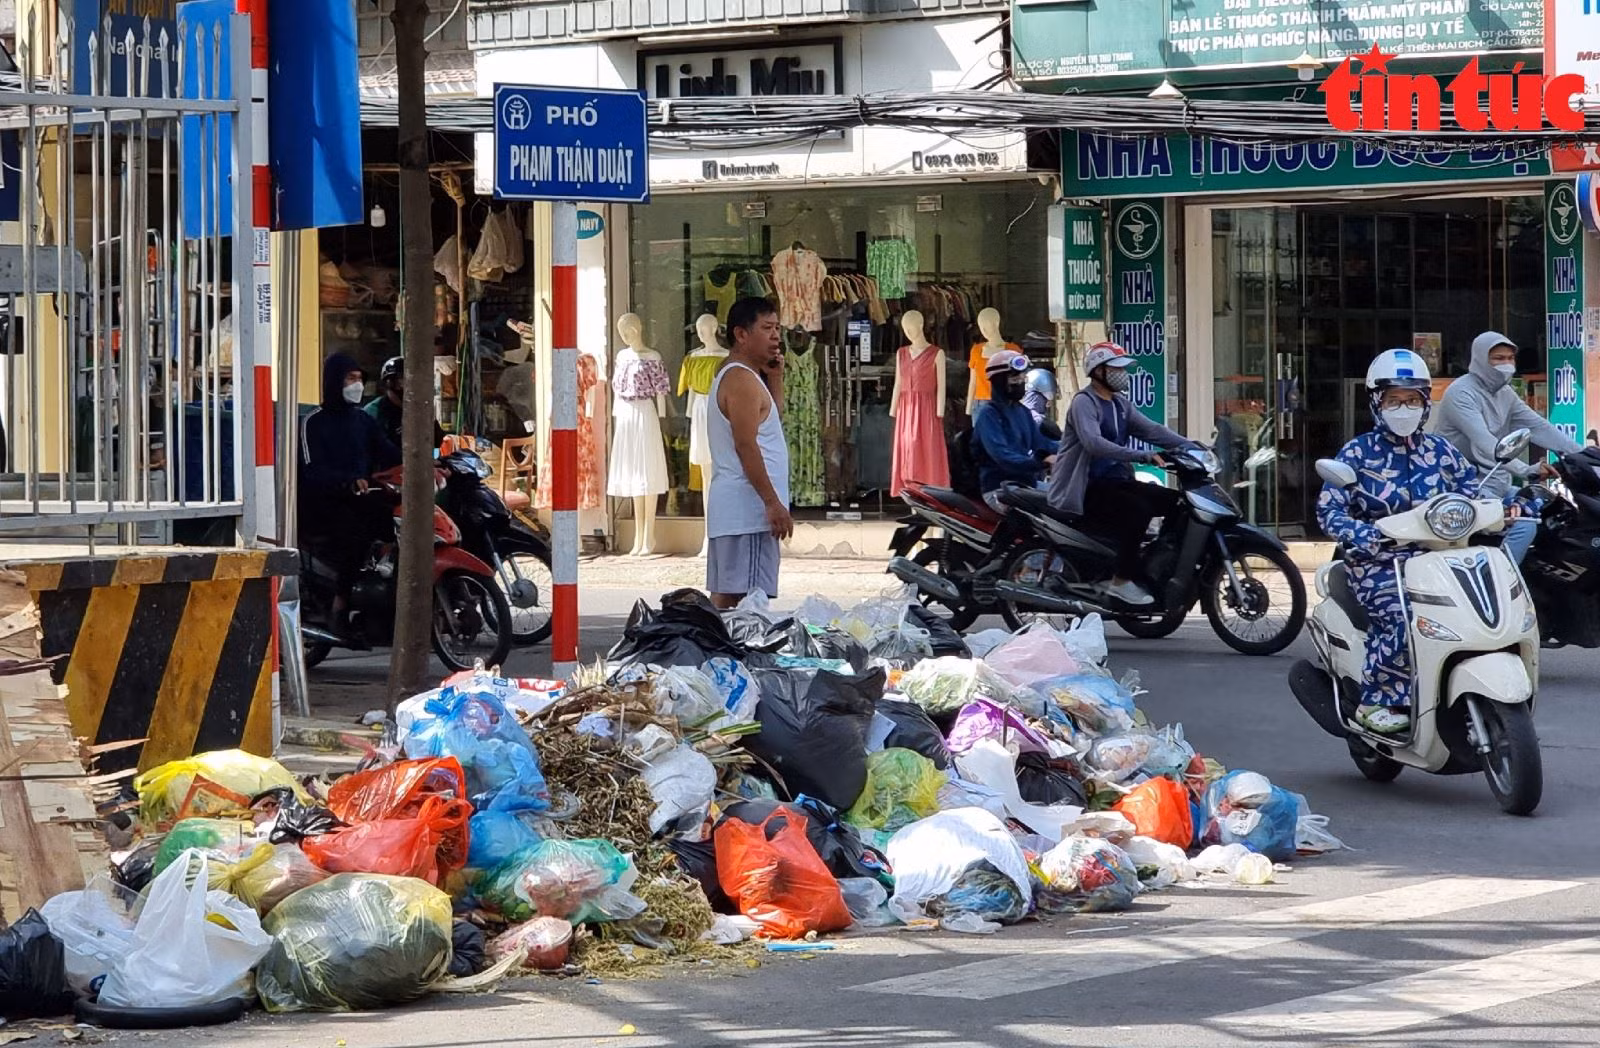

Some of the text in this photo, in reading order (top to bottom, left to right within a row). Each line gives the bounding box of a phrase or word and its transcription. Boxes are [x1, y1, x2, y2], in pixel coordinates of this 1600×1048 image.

[1169, 16, 1201, 34] BÁN
[1280, 7, 1334, 26] THÀNH
[1170, 38, 1211, 55] THỰC
[1212, 30, 1258, 50] PHẨM
[1261, 29, 1305, 47] CHỨC
[1404, 22, 1427, 39] CỤ
[1431, 21, 1441, 35] Y
[1444, 14, 1465, 34] TẾ
[547, 99, 598, 126] PHỐ
[510, 140, 633, 191] PHẠM THẬN DUẬT
[580, 217, 599, 231] NAVY
[1073, 216, 1095, 245] NHÀ
[1068, 251, 1101, 285] THUỐC
[1122, 263, 1156, 304] NHÀ
[1552, 248, 1577, 293] NHÀ
[1068, 291, 1101, 313] ĐỨC ĐẠT
[1111, 309, 1164, 356] THUỐC
[1547, 299, 1584, 349] THUỐC
[1554, 360, 1577, 405] ĐỨC
